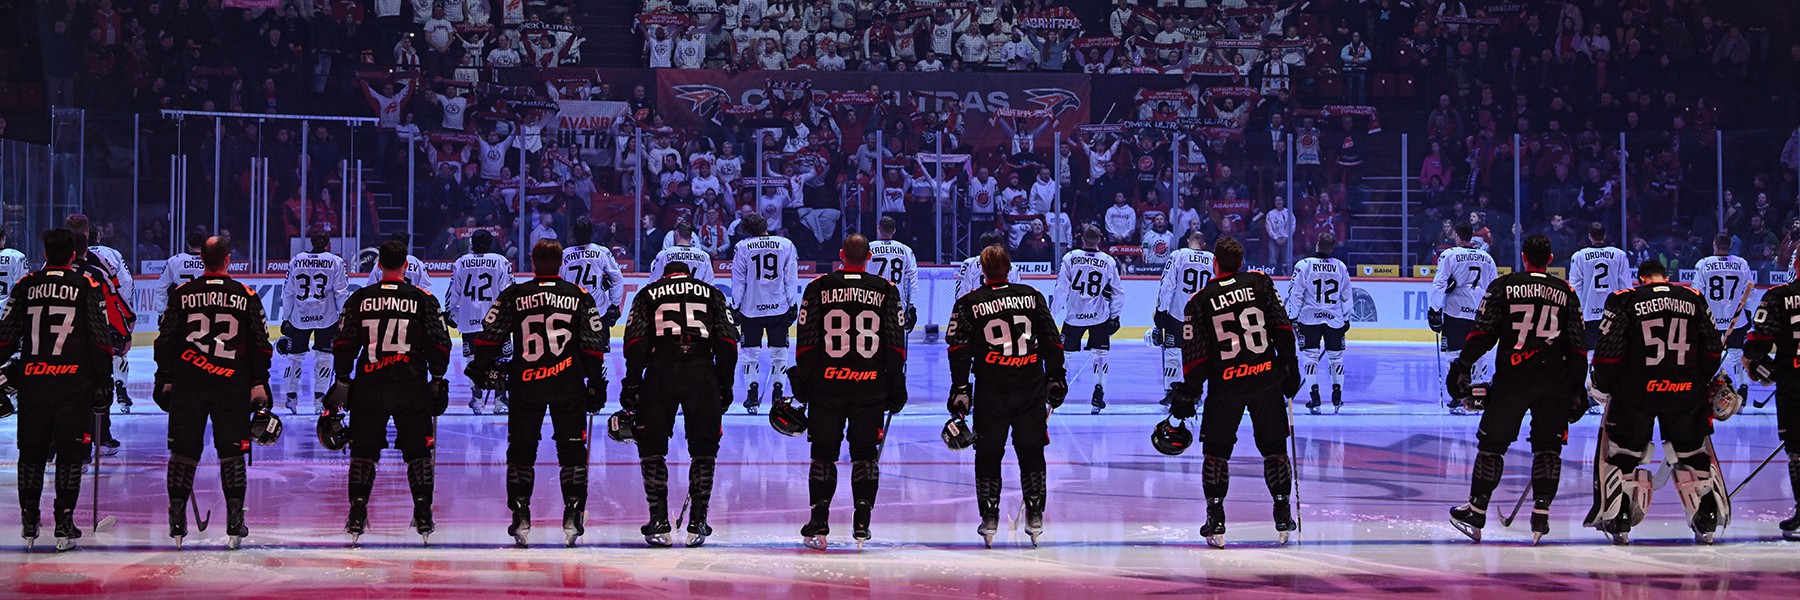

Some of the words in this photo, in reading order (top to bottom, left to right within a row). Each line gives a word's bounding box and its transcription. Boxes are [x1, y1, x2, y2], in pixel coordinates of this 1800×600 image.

[518, 22, 540, 32] OMSK
[1124, 119, 1152, 129] OMSK
[666, 252, 705, 262] GRIGORENKO
[747, 240, 780, 250] NIKONOV
[1584, 251, 1615, 261] DRONOV
[226, 262, 249, 271] NBET
[461, 259, 498, 268] YUSUPOV
[563, 250, 600, 265] KRAVTSOV
[751, 253, 779, 281] 19
[1015, 264, 1048, 273] HL.RU
[1189, 255, 1209, 265] LEIVO
[1312, 263, 1336, 273] RYKOV
[1705, 261, 1741, 271] SVETLAKOV
[568, 263, 597, 290] 74
[872, 257, 904, 285] 78
[1182, 267, 1212, 294] 90
[1247, 265, 1276, 275] Haier
[1468, 266, 1481, 291] 7
[1594, 262, 1609, 288] 2
[27, 283, 79, 301] OKULOV
[295, 272, 328, 300] 33
[463, 272, 492, 301] 42
[648, 282, 710, 300] YAKUPOV
[1072, 269, 1103, 297] 48
[1312, 278, 1339, 305] 12
[1506, 283, 1568, 307] PROKHORKIN
[1709, 275, 1741, 301] 87
[181, 291, 248, 312] POTURALSKI
[360, 296, 418, 314] IGUMNOV
[515, 292, 580, 312] CHISTYAKOV
[821, 287, 885, 307] BLAZHIYEVSKY
[972, 295, 1036, 319] PONOMARYOV
[1210, 287, 1256, 311] LAJOIE
[1634, 296, 1696, 316] SEREBRYAKOV
[27, 306, 76, 356] 17
[654, 302, 709, 338] 65
[1509, 304, 1561, 350] 74
[185, 312, 240, 360] 22
[362, 318, 411, 363] 14
[521, 312, 572, 362] 66
[823, 309, 881, 358] 88
[1211, 306, 1269, 361] 58
[1641, 318, 1691, 366] 54
